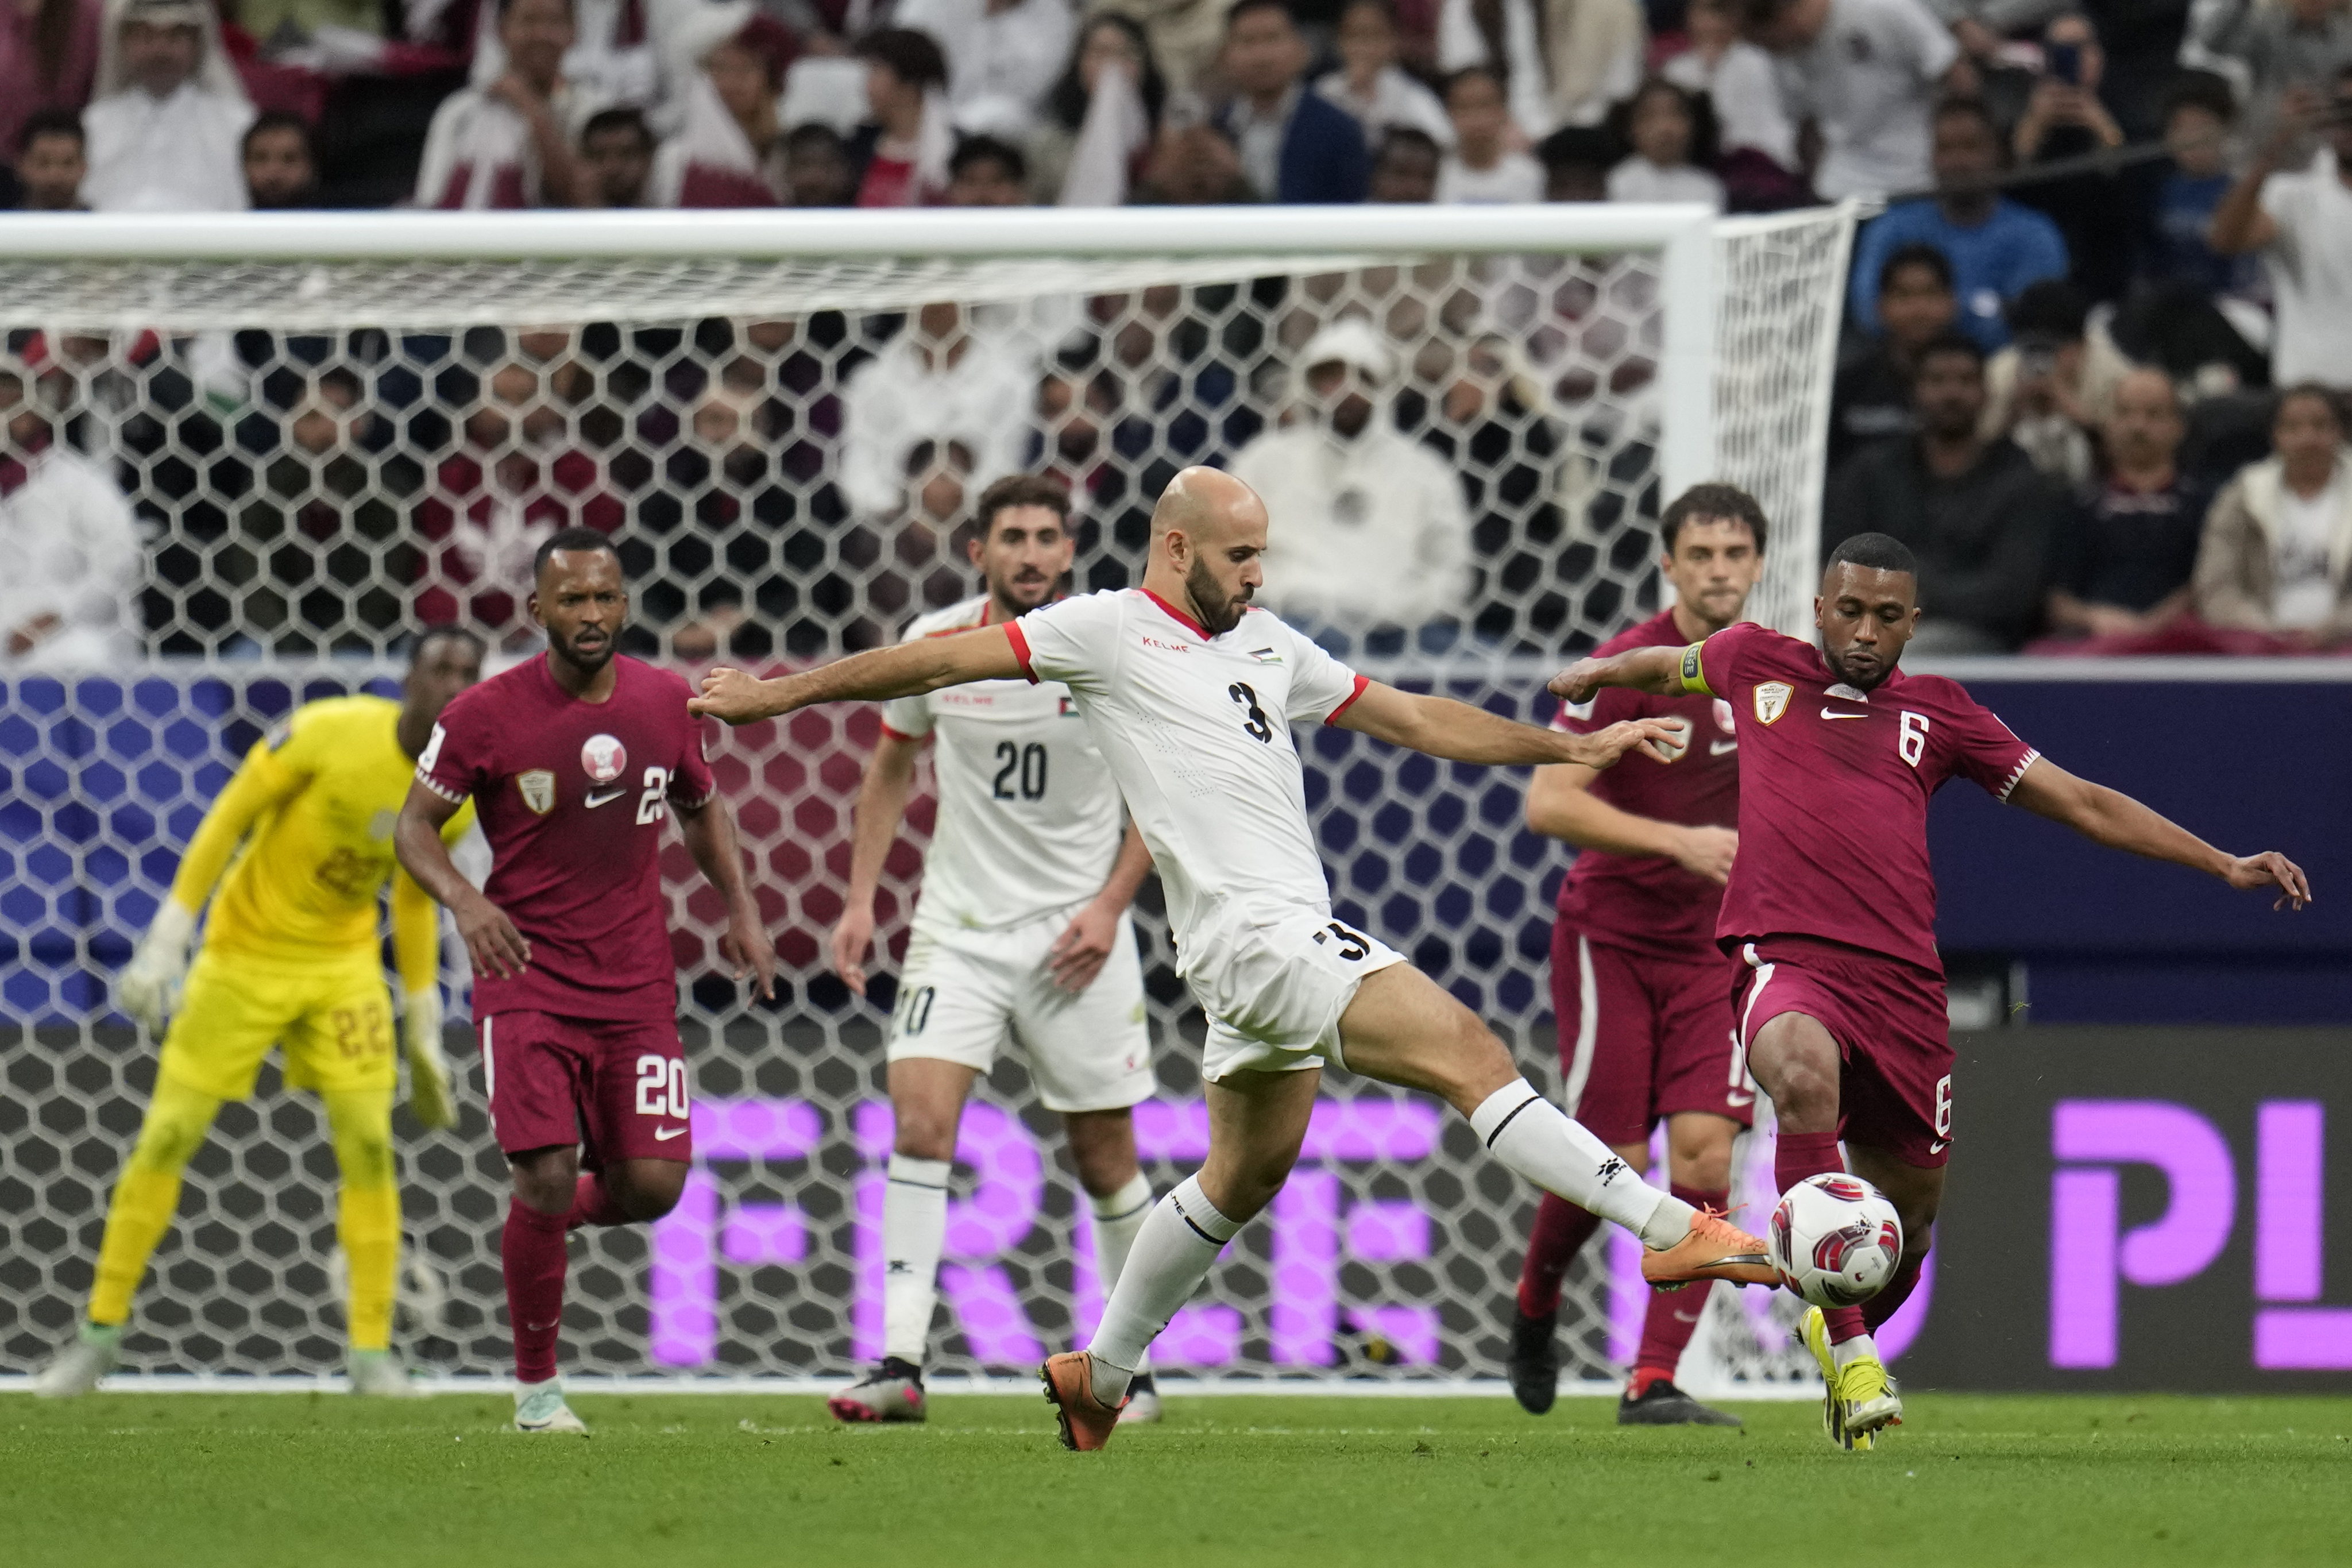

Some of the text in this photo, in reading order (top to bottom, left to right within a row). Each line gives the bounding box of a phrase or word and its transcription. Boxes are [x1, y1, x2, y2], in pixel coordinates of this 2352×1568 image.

[1143, 636, 1190, 654] KELME
[943, 694, 993, 706] KELME
[1229, 682, 1272, 744] 3
[1899, 710, 1929, 768] 6
[636, 767, 675, 825] 2
[994, 740, 1048, 801] 20
[1312, 923, 1370, 961] 3
[332, 1001, 392, 1058] 22
[635, 1054, 689, 1119] 20
[1935, 1073, 1952, 1137] 6
[650, 1098, 1439, 1367] FREE
